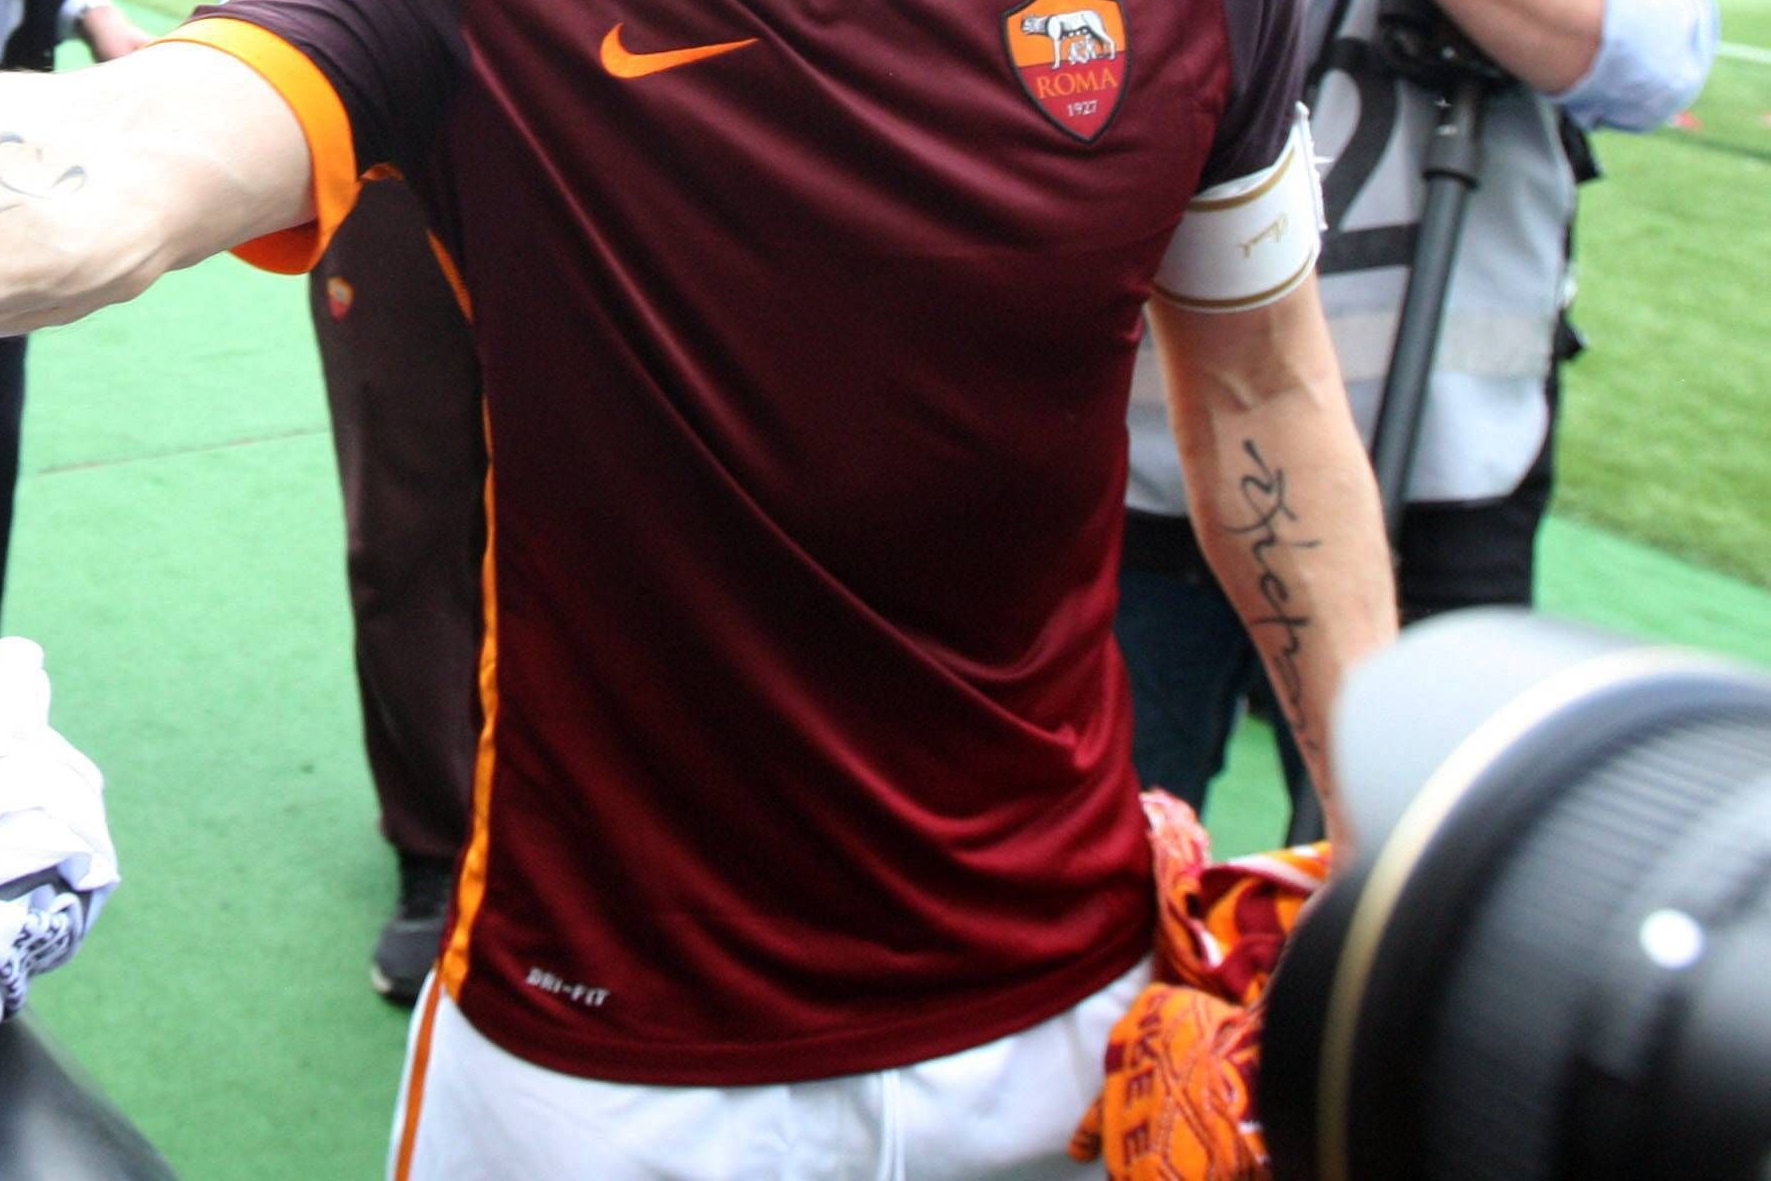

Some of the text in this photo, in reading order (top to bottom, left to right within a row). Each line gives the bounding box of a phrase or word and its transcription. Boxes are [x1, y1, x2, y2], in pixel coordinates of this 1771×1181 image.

[1035, 67, 1119, 100] ROMA
[1066, 100, 1099, 118] 1927
[526, 966, 610, 1007] DRI-FIT
